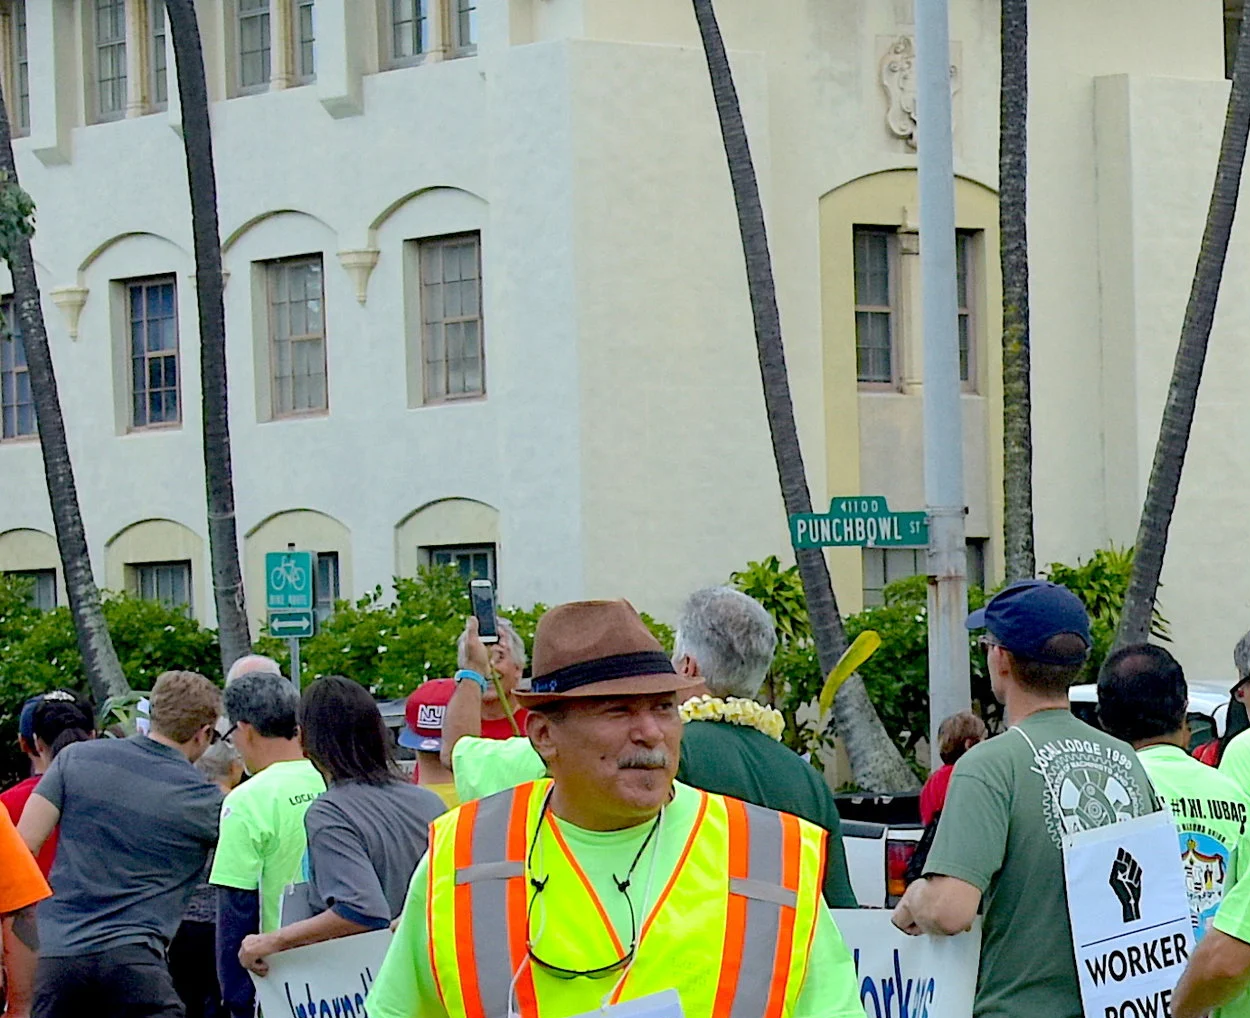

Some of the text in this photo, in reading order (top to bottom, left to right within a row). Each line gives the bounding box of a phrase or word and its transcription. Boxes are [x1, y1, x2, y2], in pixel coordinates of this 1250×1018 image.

[848, 500, 878, 513] 1100
[797, 516, 920, 543] PUNCHBOWL ST
[1057, 739, 1103, 755] LODGE
[1171, 797, 1187, 818] #1
[1207, 799, 1247, 823] IUBAC
[1085, 932, 1190, 987] WORKER
